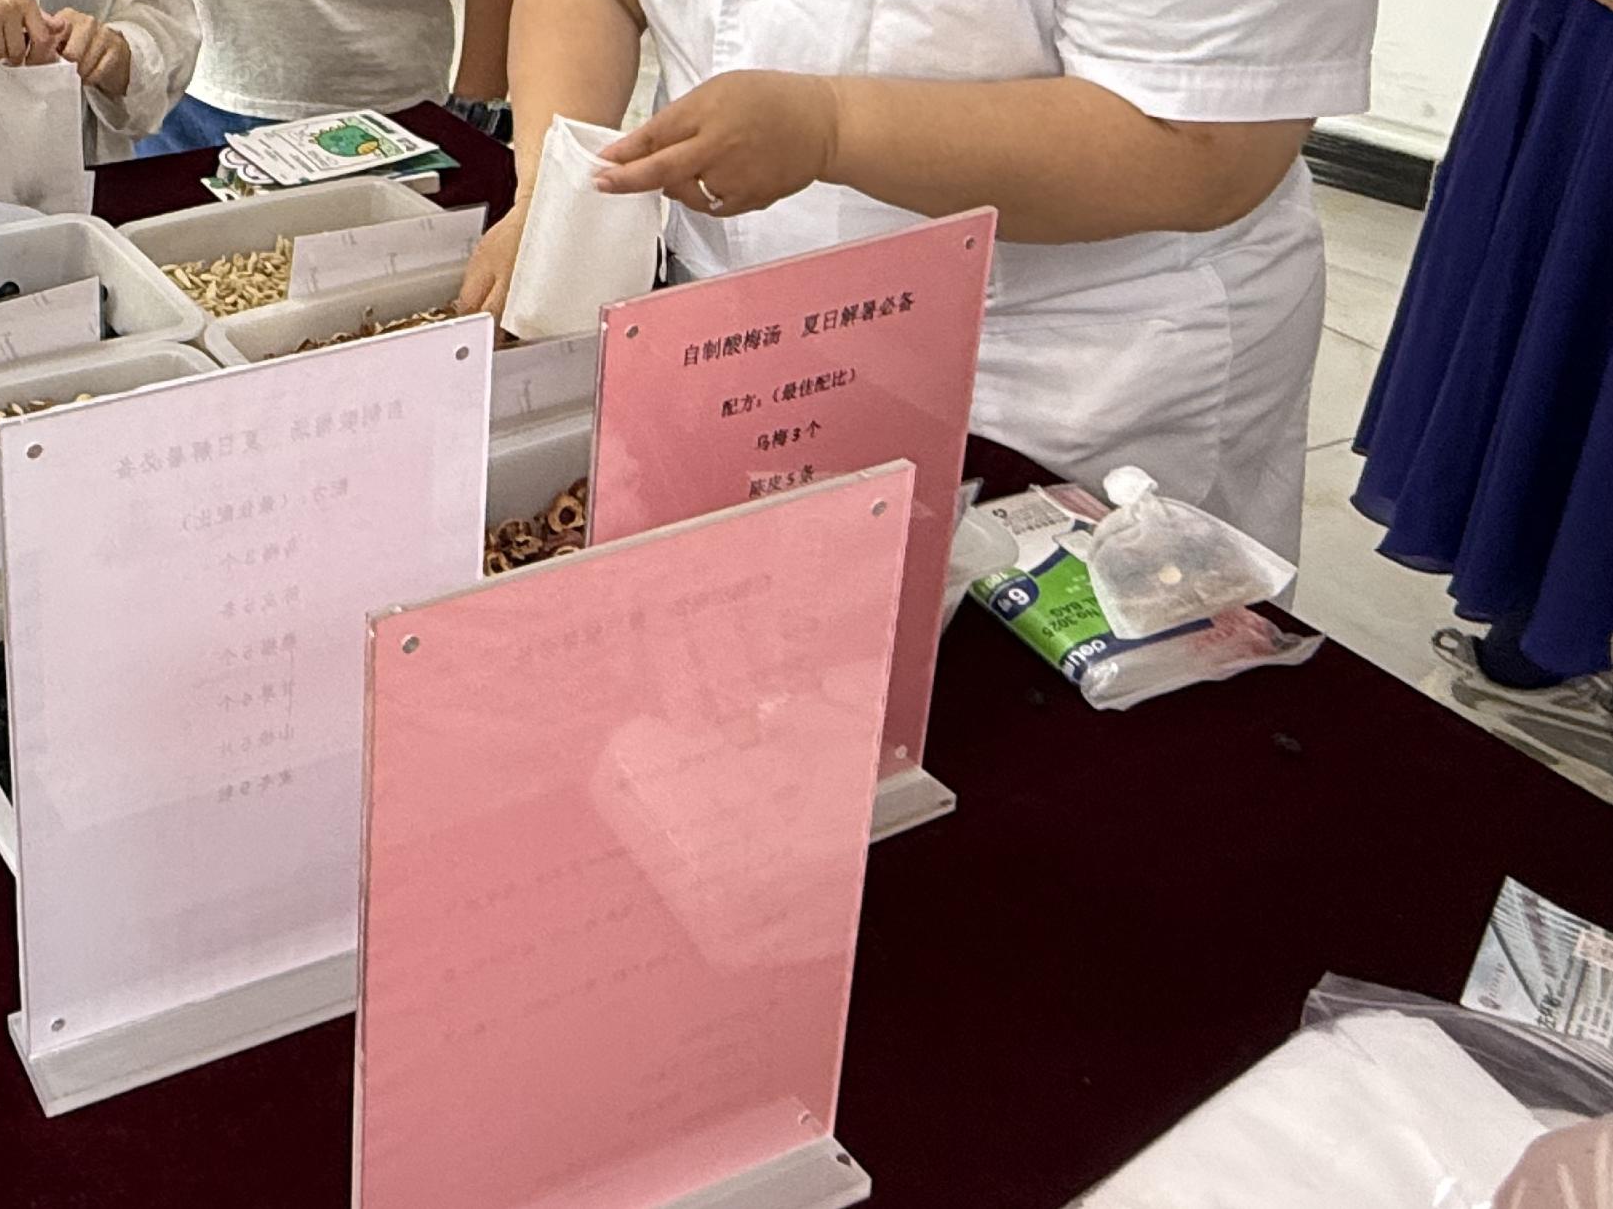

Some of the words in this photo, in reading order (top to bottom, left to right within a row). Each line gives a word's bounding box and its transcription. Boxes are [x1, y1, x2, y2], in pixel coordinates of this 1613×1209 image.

[683, 324, 783, 367] 自制酸梅汤
[800, 291, 916, 339] 夏日解暑必备
